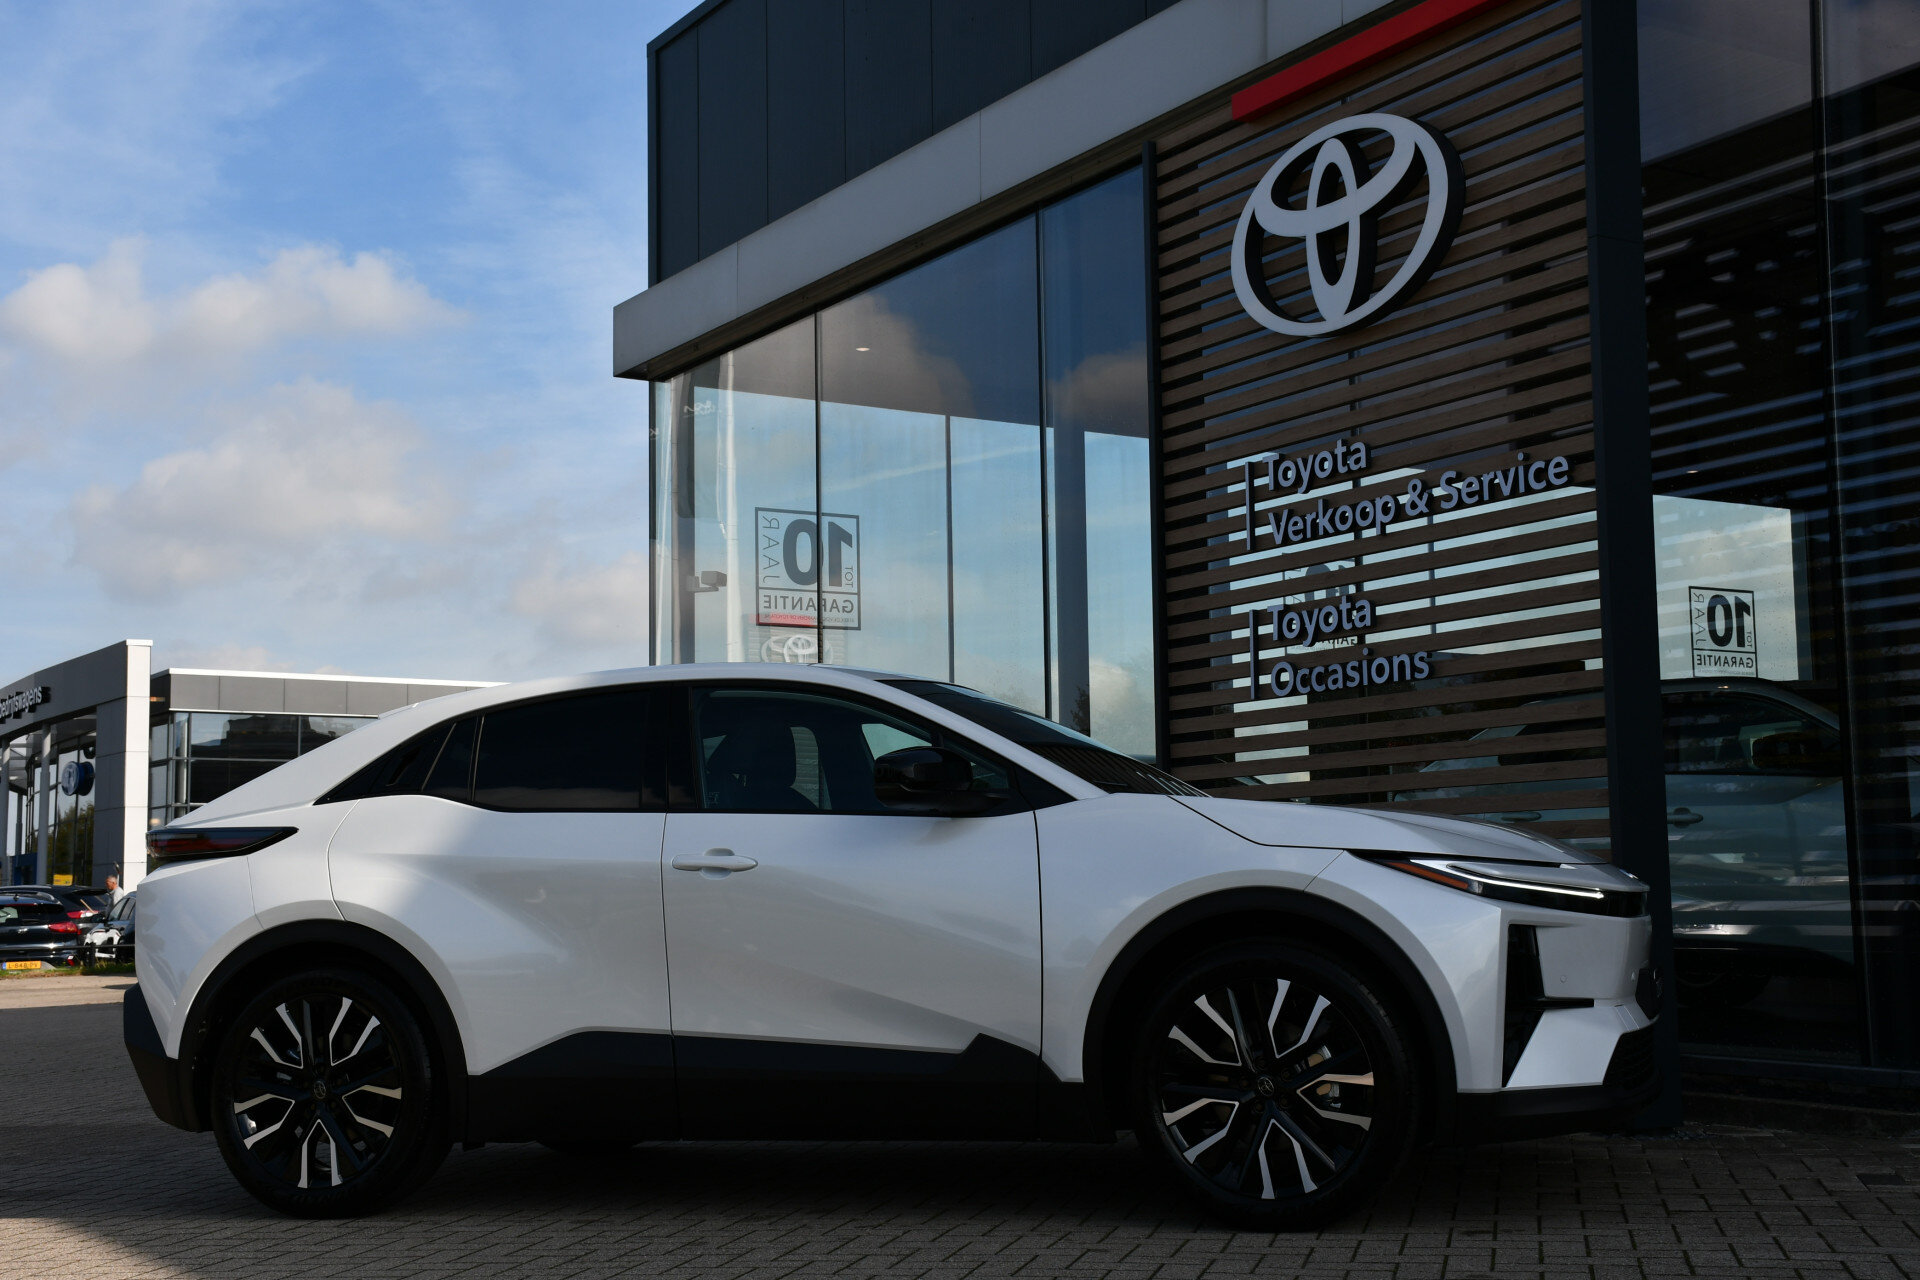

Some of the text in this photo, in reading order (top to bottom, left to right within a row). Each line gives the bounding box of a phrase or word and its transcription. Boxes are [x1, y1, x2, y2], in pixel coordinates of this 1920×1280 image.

[1263, 439, 1367, 494] Toyota
[1268, 452, 1569, 545] Verkoop & Service
[1267, 595, 1372, 647] Toyota
[1271, 648, 1431, 697] Occasions
